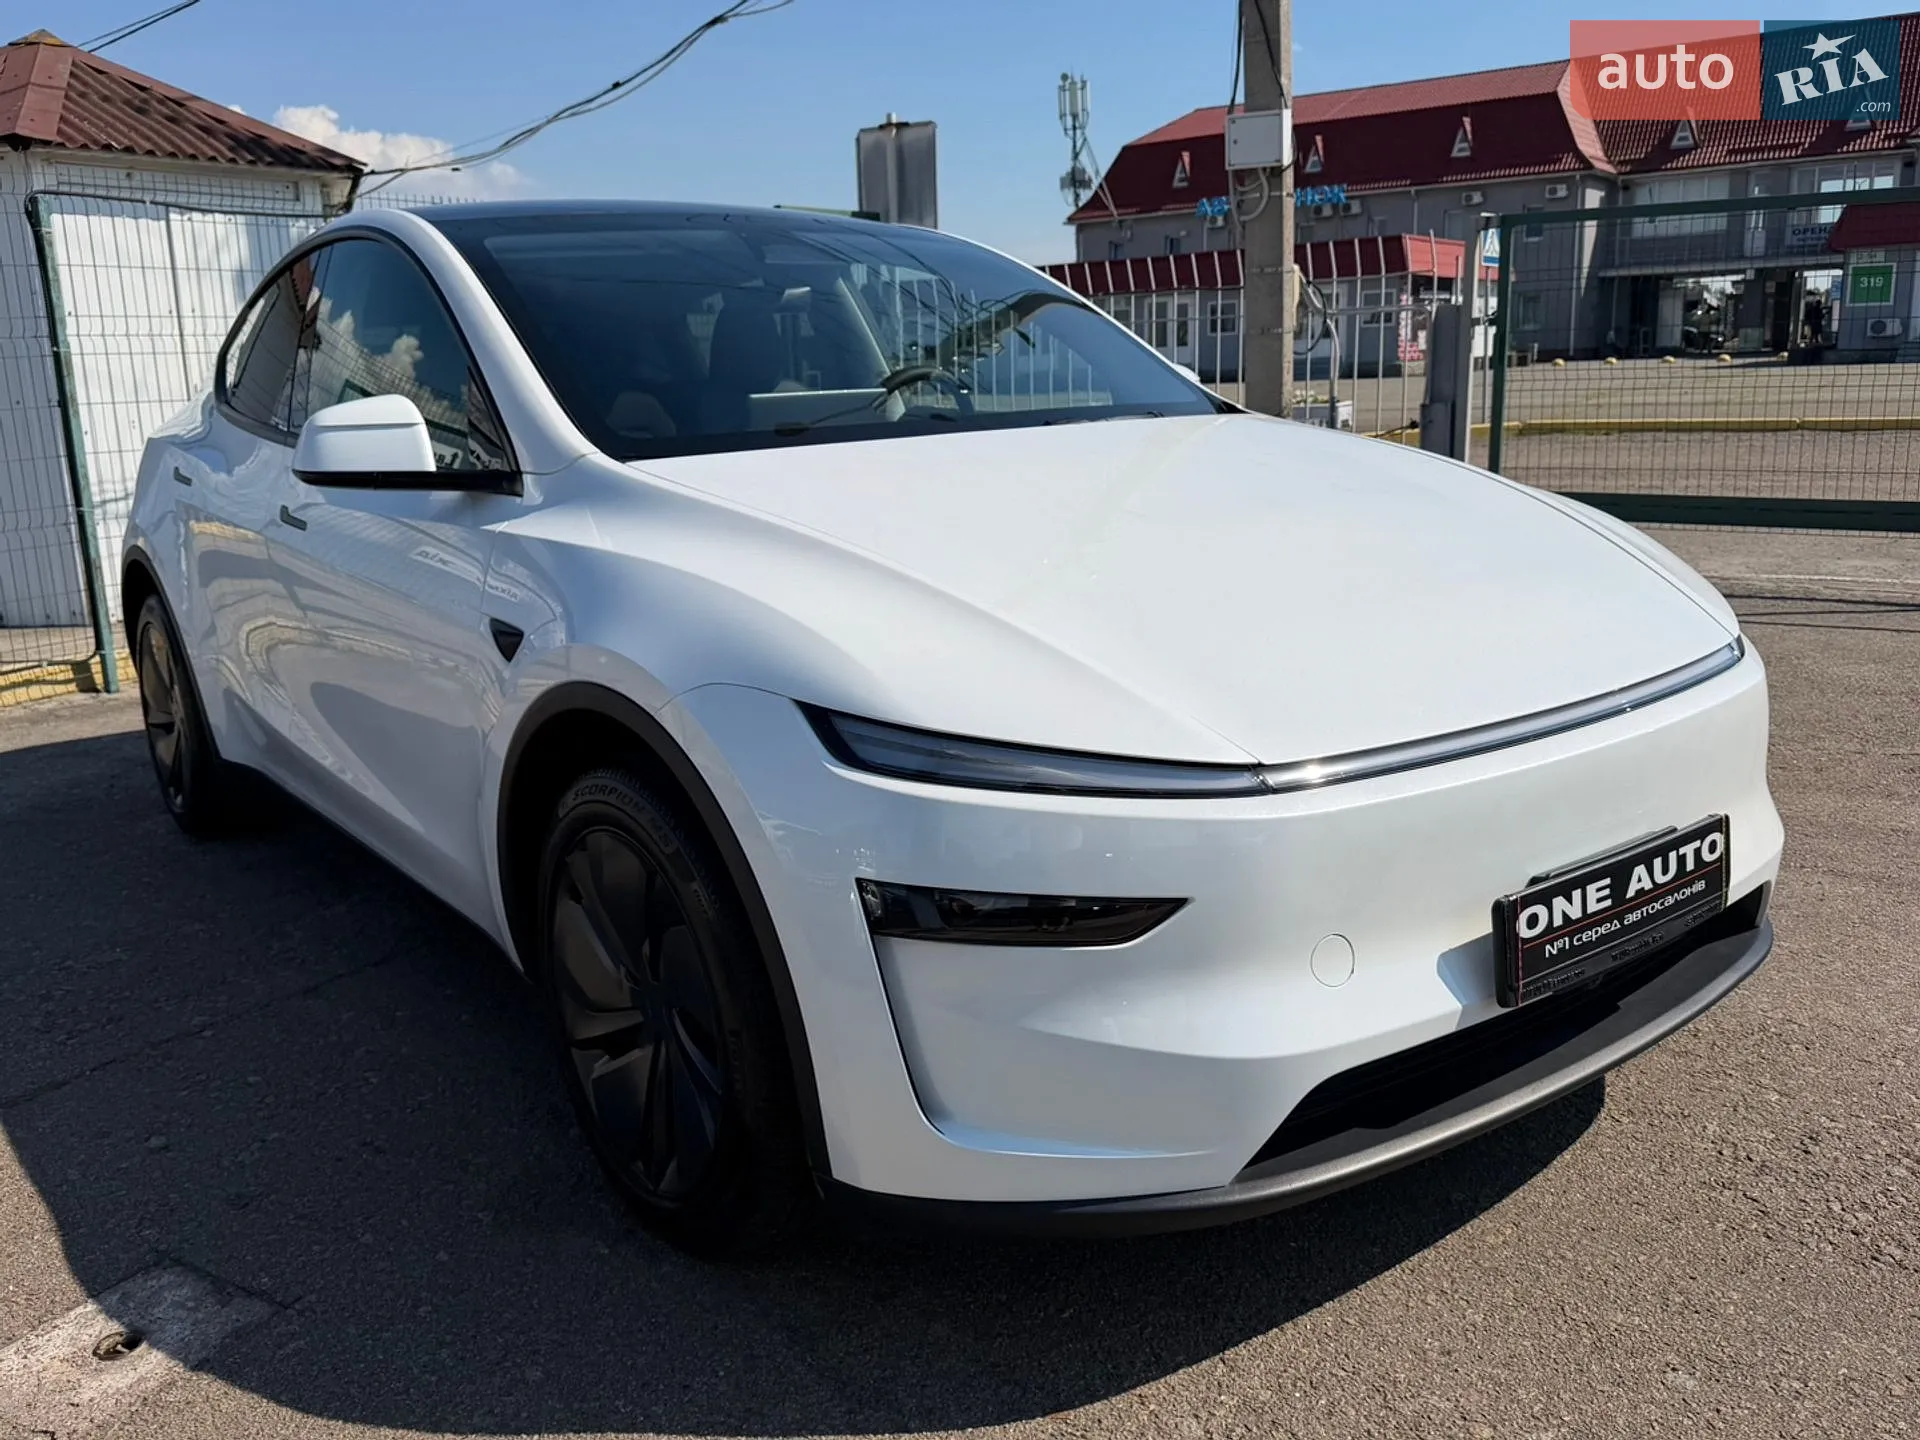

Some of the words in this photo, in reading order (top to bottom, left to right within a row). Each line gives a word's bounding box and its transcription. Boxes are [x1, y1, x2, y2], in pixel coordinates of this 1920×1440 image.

[1860, 277, 1883, 288] 319
[572, 783, 645, 812] SCORPION
[1516, 877, 1612, 939] ONE
[1626, 832, 1724, 899] AUTO
[1573, 921, 1622, 947] серед
[1623, 879, 1707, 925] автосалонів
